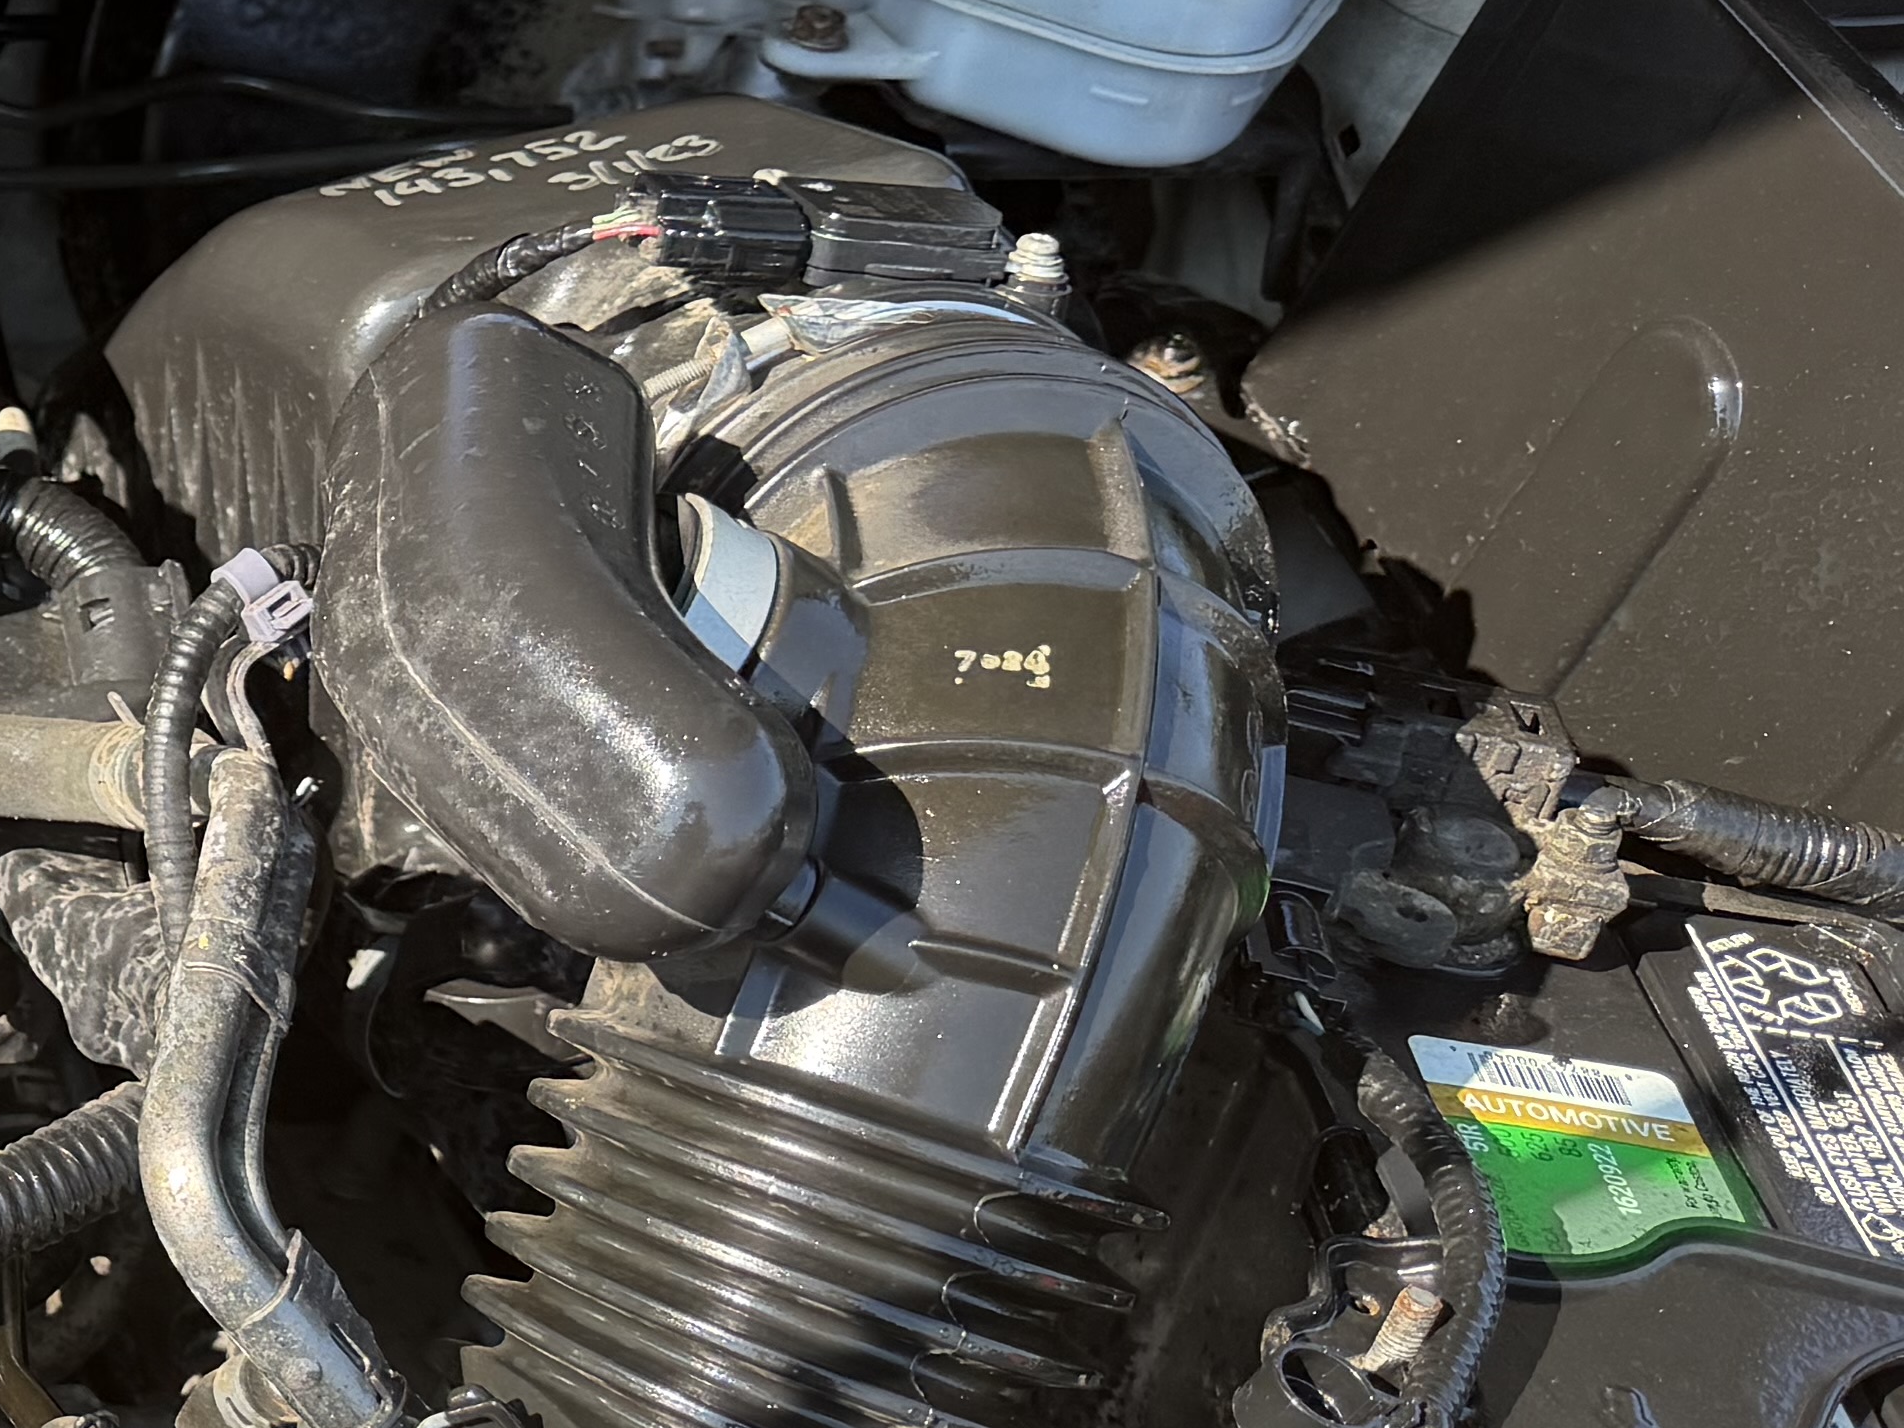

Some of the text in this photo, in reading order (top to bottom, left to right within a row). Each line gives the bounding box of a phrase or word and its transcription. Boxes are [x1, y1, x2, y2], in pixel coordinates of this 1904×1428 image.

[374, 130, 627, 206] 143,752
[1740, 1052, 1767, 1079] CAPS
[1743, 1086, 1766, 1106] THE
[1756, 1080, 1782, 1106] VENT
[1832, 1090, 1867, 1123] FAST
[1464, 1093, 1676, 1142] AUTOMOTIVE
[1772, 1109, 1798, 1136] KEEP
[1818, 1101, 1849, 1128] GET
[1455, 1122, 1490, 1154] 51R
[1522, 1130, 1554, 1163] 625
[1765, 1125, 1791, 1149] OUT
[1768, 1050, 1875, 1212] FLUSH EYES IMMEDIATELY
[1853, 1124, 1887, 1160] HELP
[1553, 1136, 1584, 1159] 85
[1587, 1142, 1643, 1216] 1620922
[1779, 1150, 1809, 1180] KEEP
[1800, 1161, 1825, 1185] NOT
[1863, 1180, 1898, 1215] WITH
